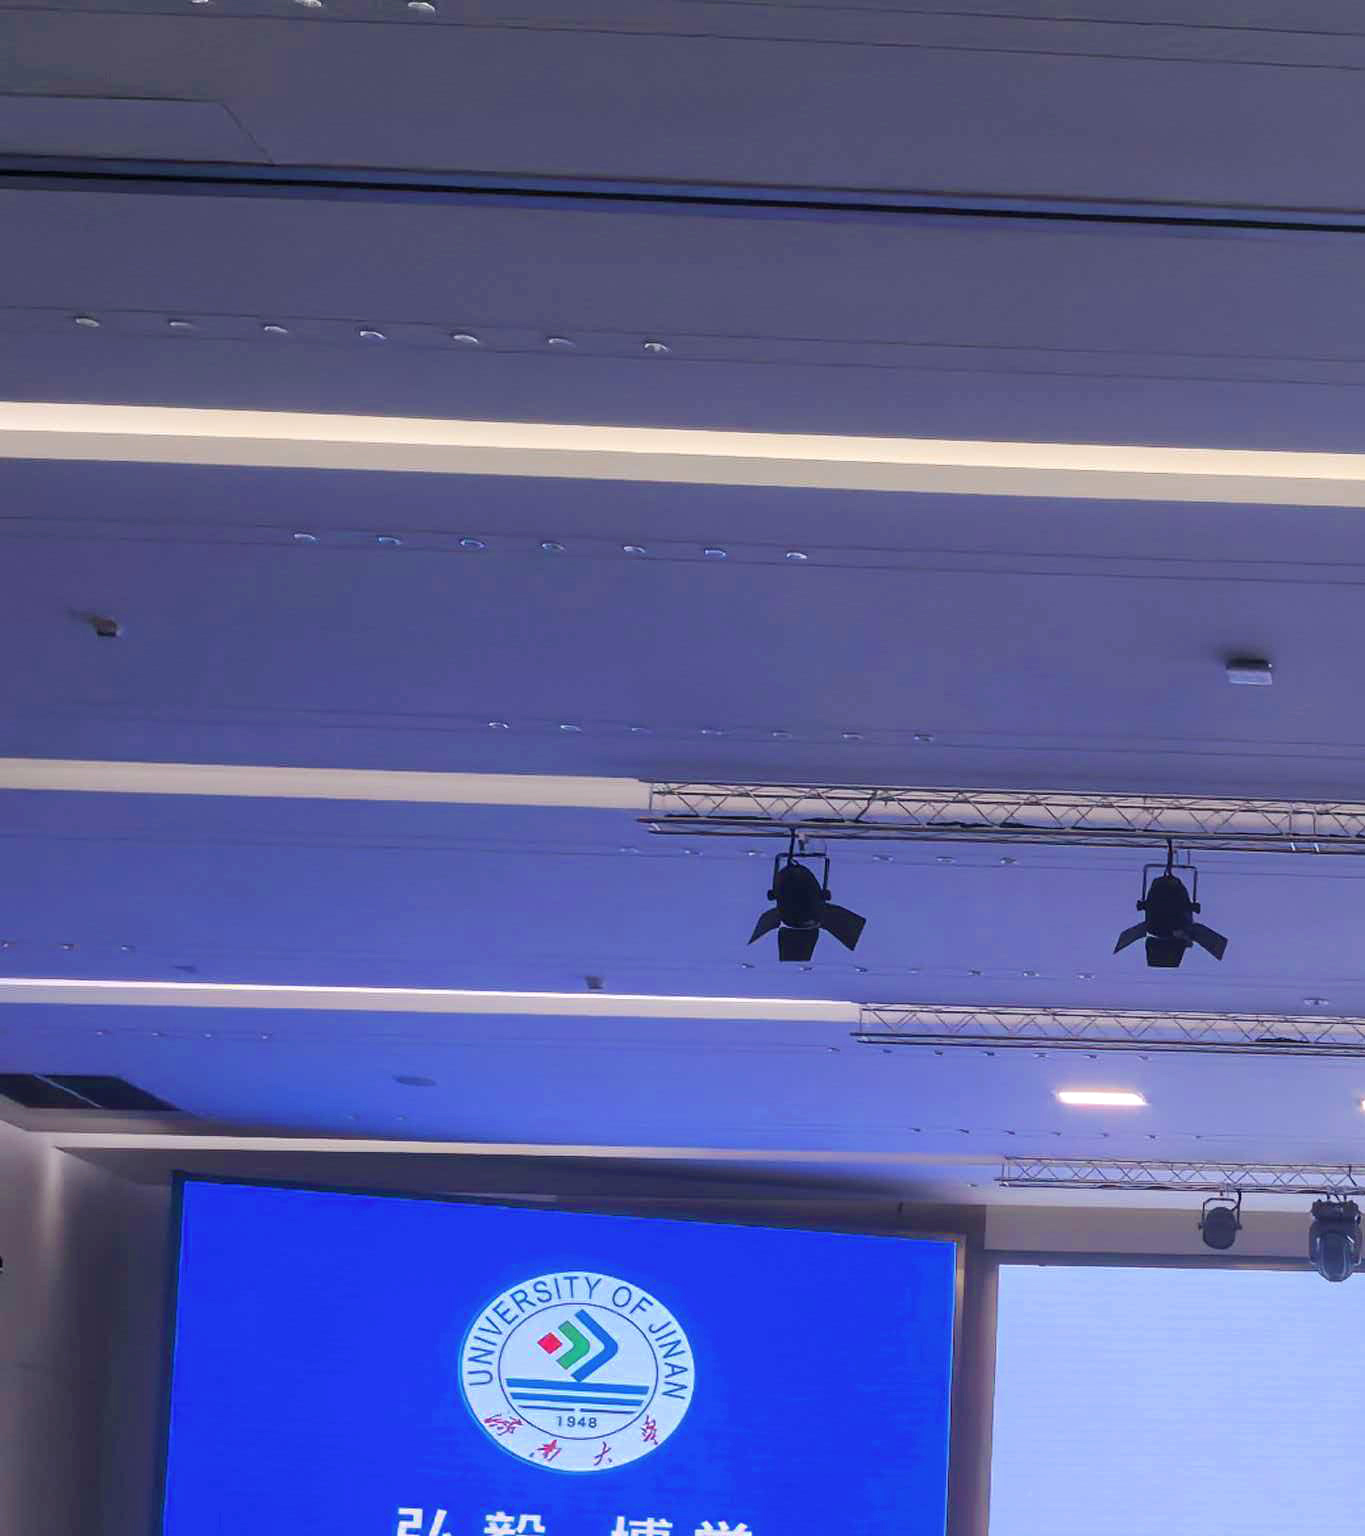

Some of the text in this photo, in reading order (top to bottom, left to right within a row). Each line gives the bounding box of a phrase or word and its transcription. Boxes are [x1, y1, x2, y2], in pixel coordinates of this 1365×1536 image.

[468, 1276, 688, 1400] UNIVERSITY OF JINAN
[556, 1416, 598, 1428] 1948
